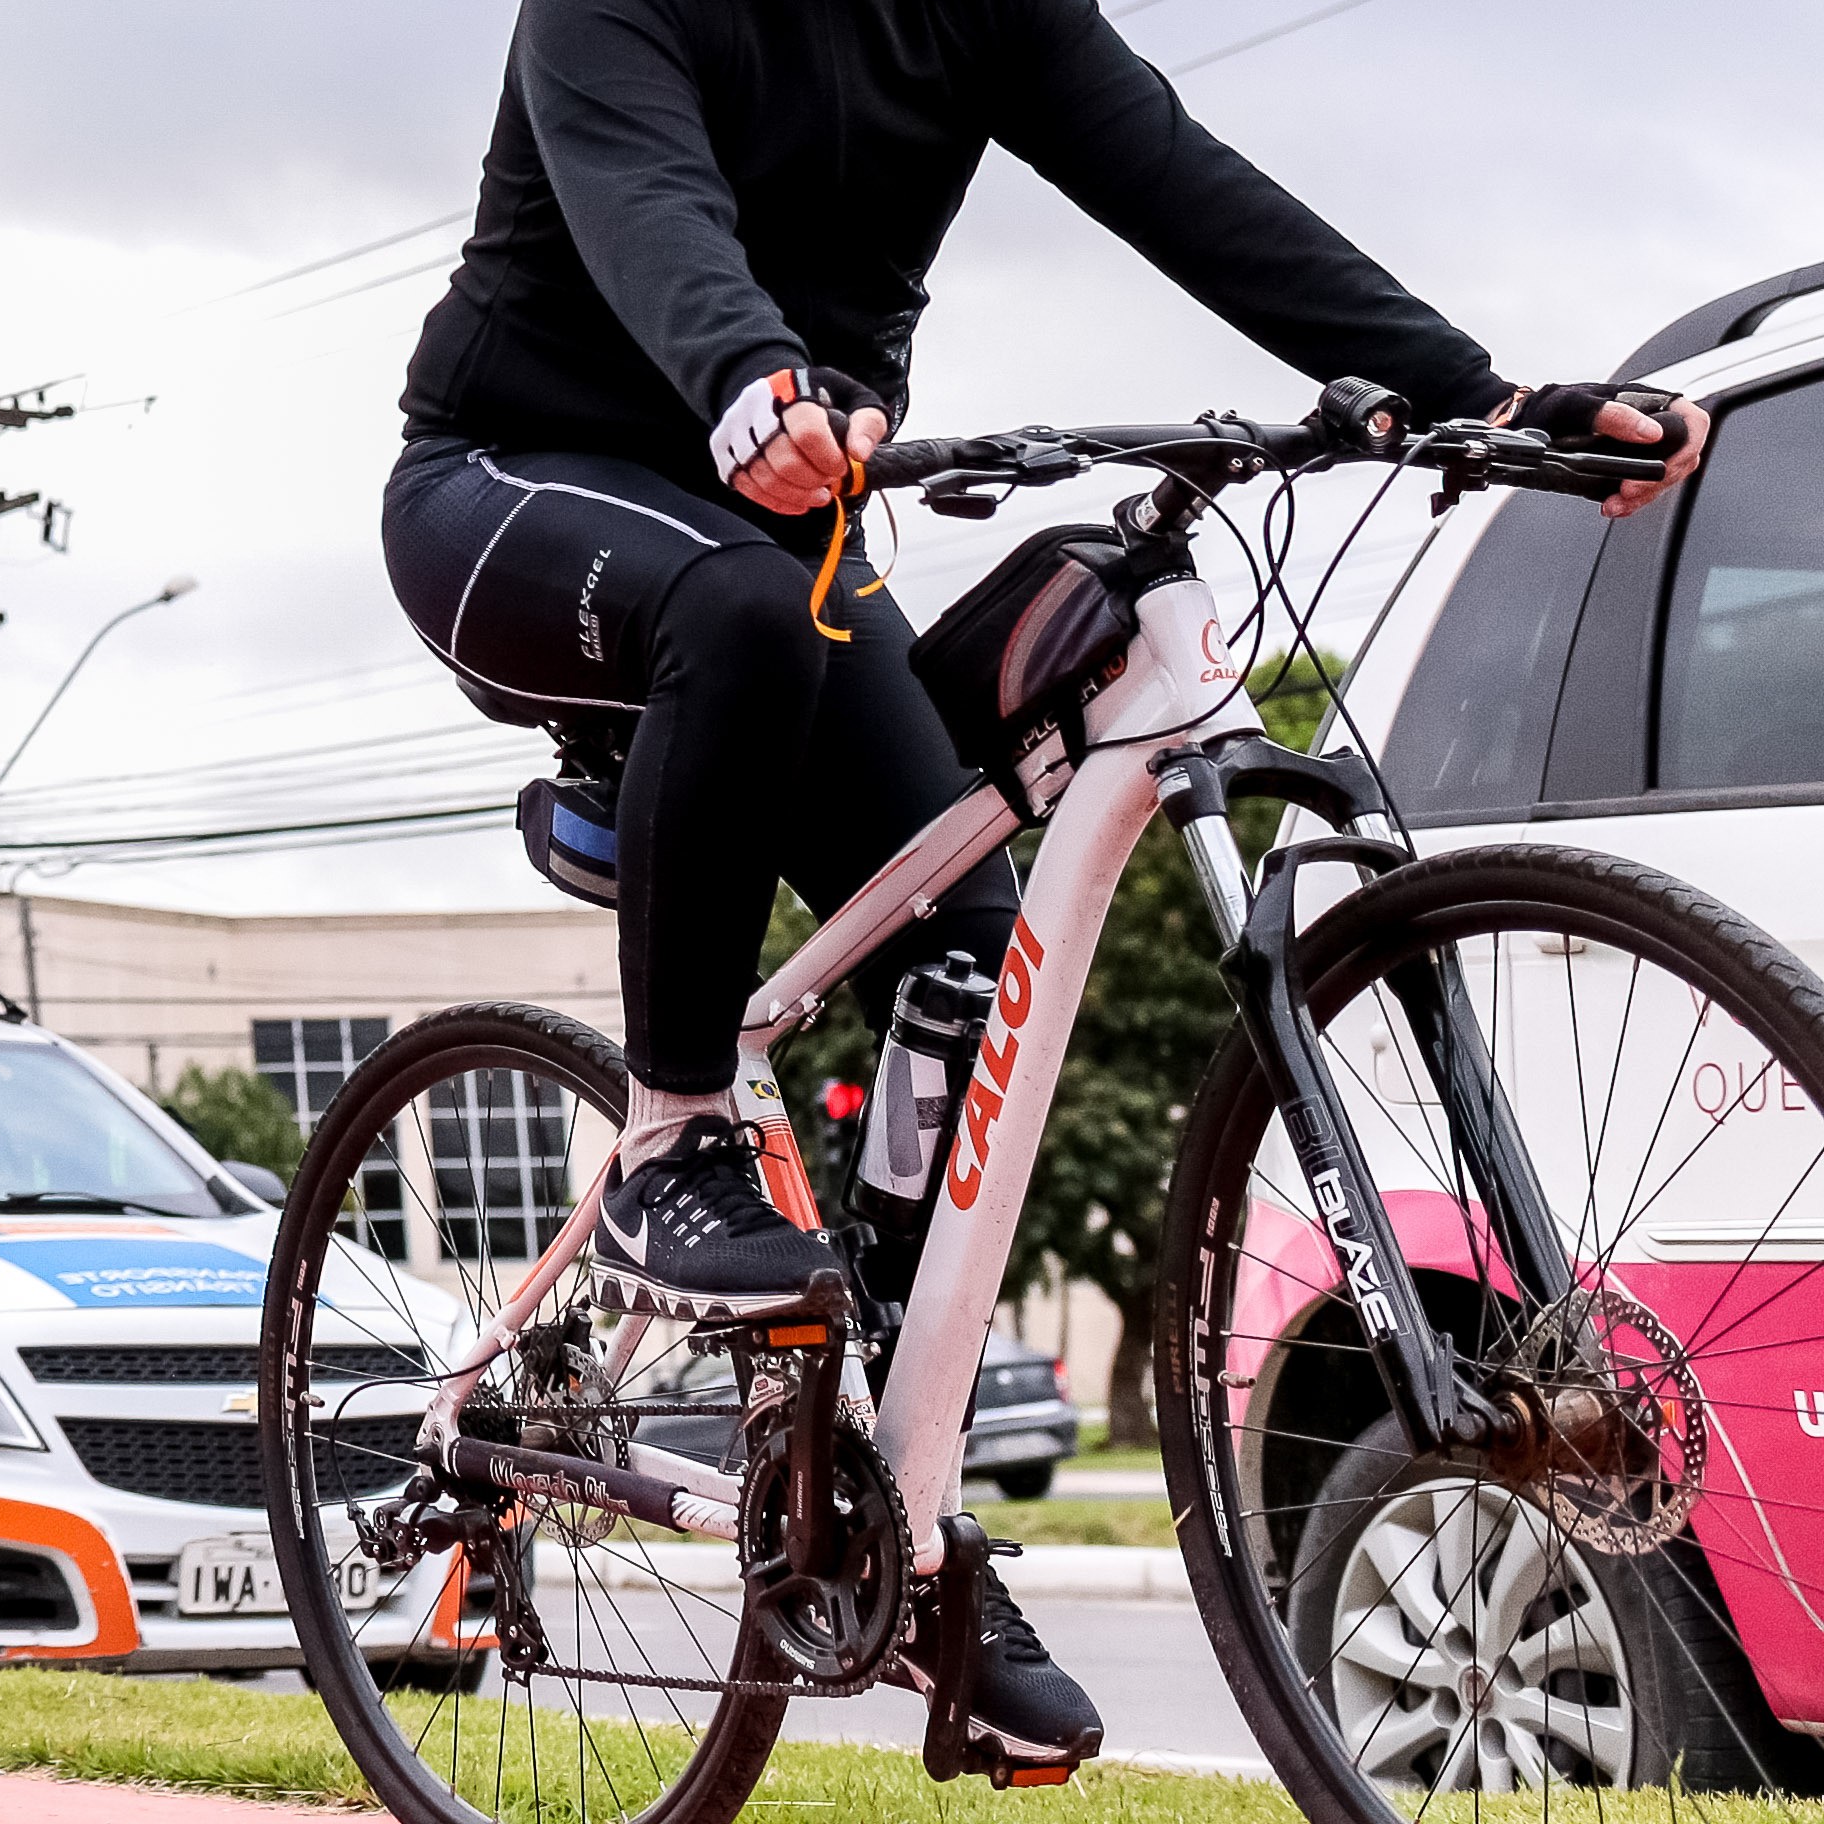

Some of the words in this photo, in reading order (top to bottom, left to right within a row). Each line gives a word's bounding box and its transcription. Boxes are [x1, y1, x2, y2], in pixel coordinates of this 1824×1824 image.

[947, 911, 1046, 1211] CALOI
[1312, 1167, 1398, 1339] BLAZE
[779, 1638, 815, 1670] SHIMANO
